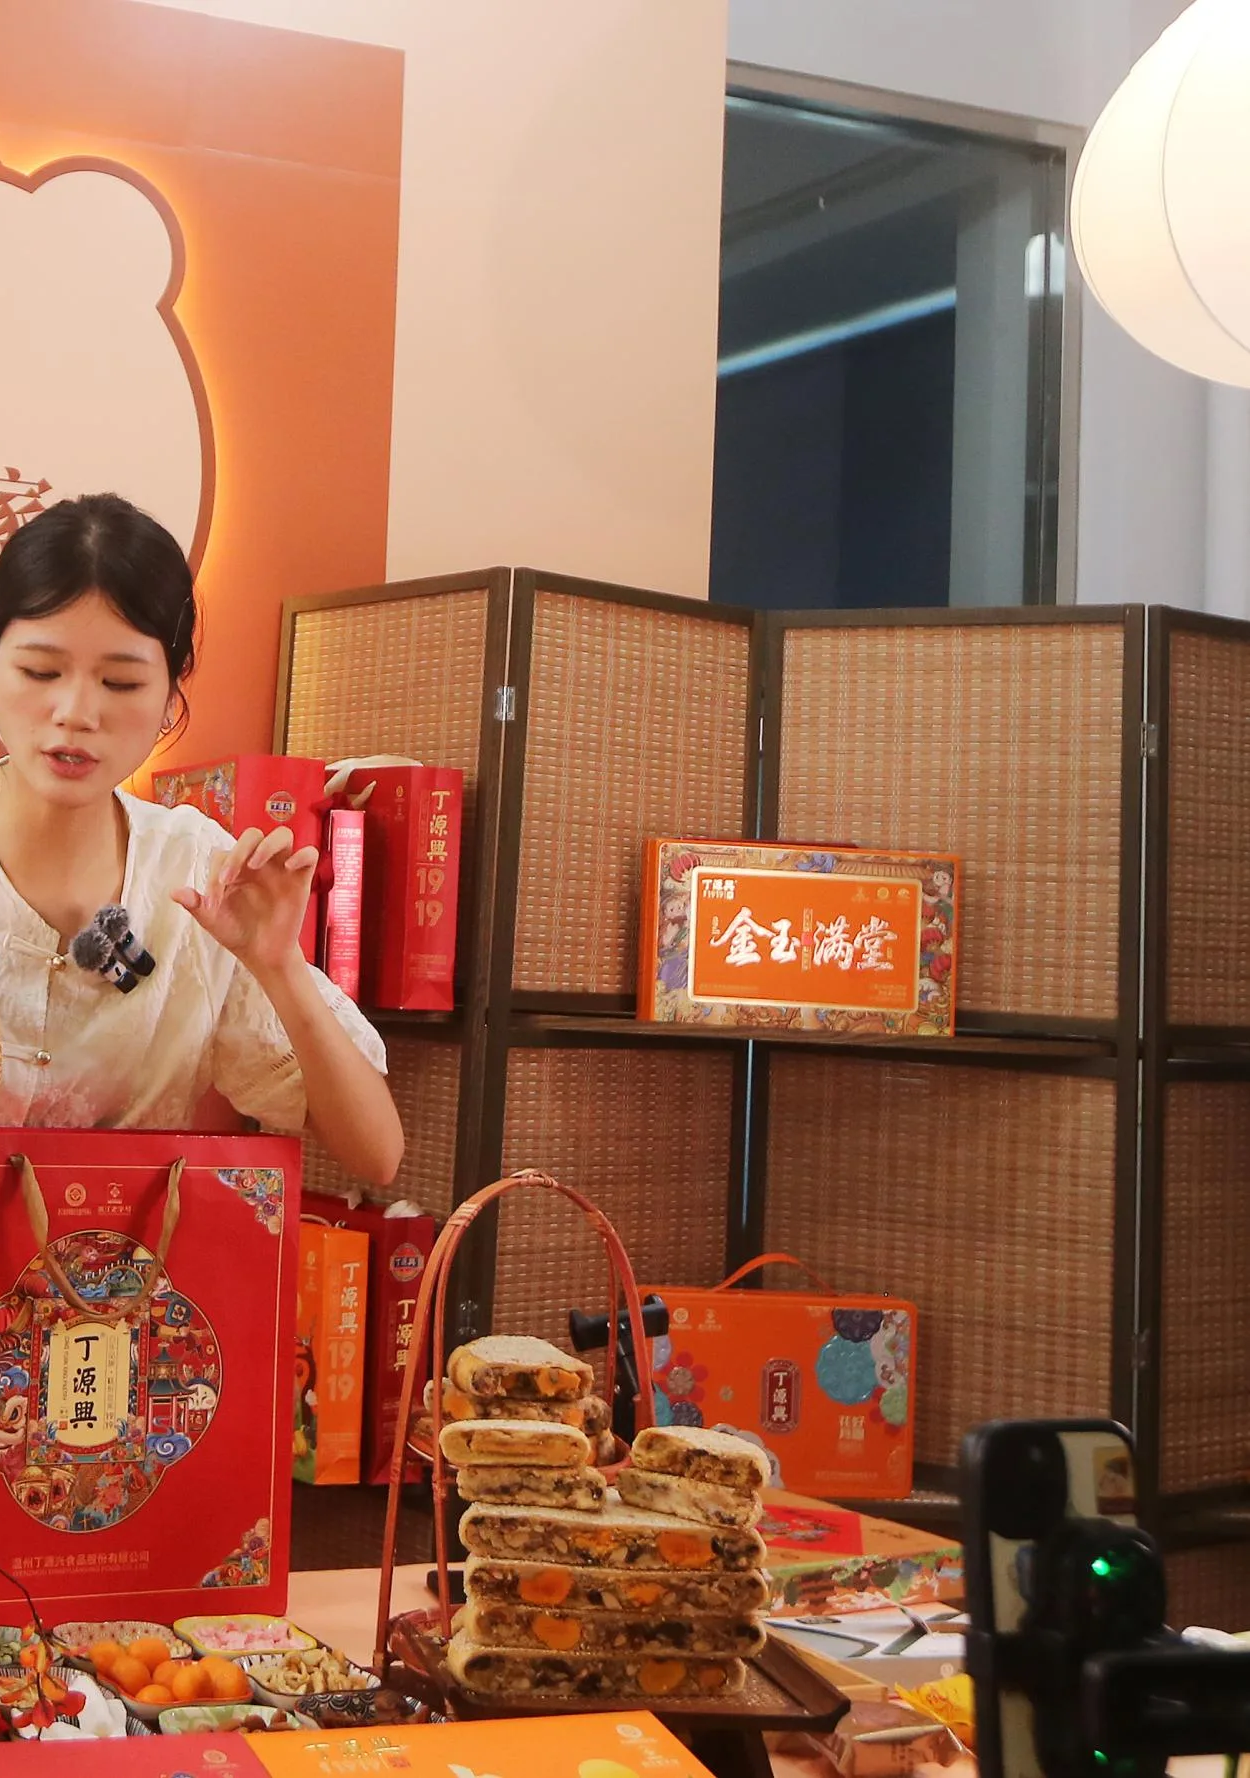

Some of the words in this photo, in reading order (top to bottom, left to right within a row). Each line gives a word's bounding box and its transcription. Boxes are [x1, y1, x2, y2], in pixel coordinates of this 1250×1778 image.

[427, 790, 451, 862] 丁源興
[416, 867, 446, 895] 19
[414, 900, 444, 927] 19
[338, 1262, 361, 1334] 丁源興
[328, 1340, 356, 1369] 19
[70, 1335, 100, 1430] 丁源興
[327, 1373, 355, 1401] 19
